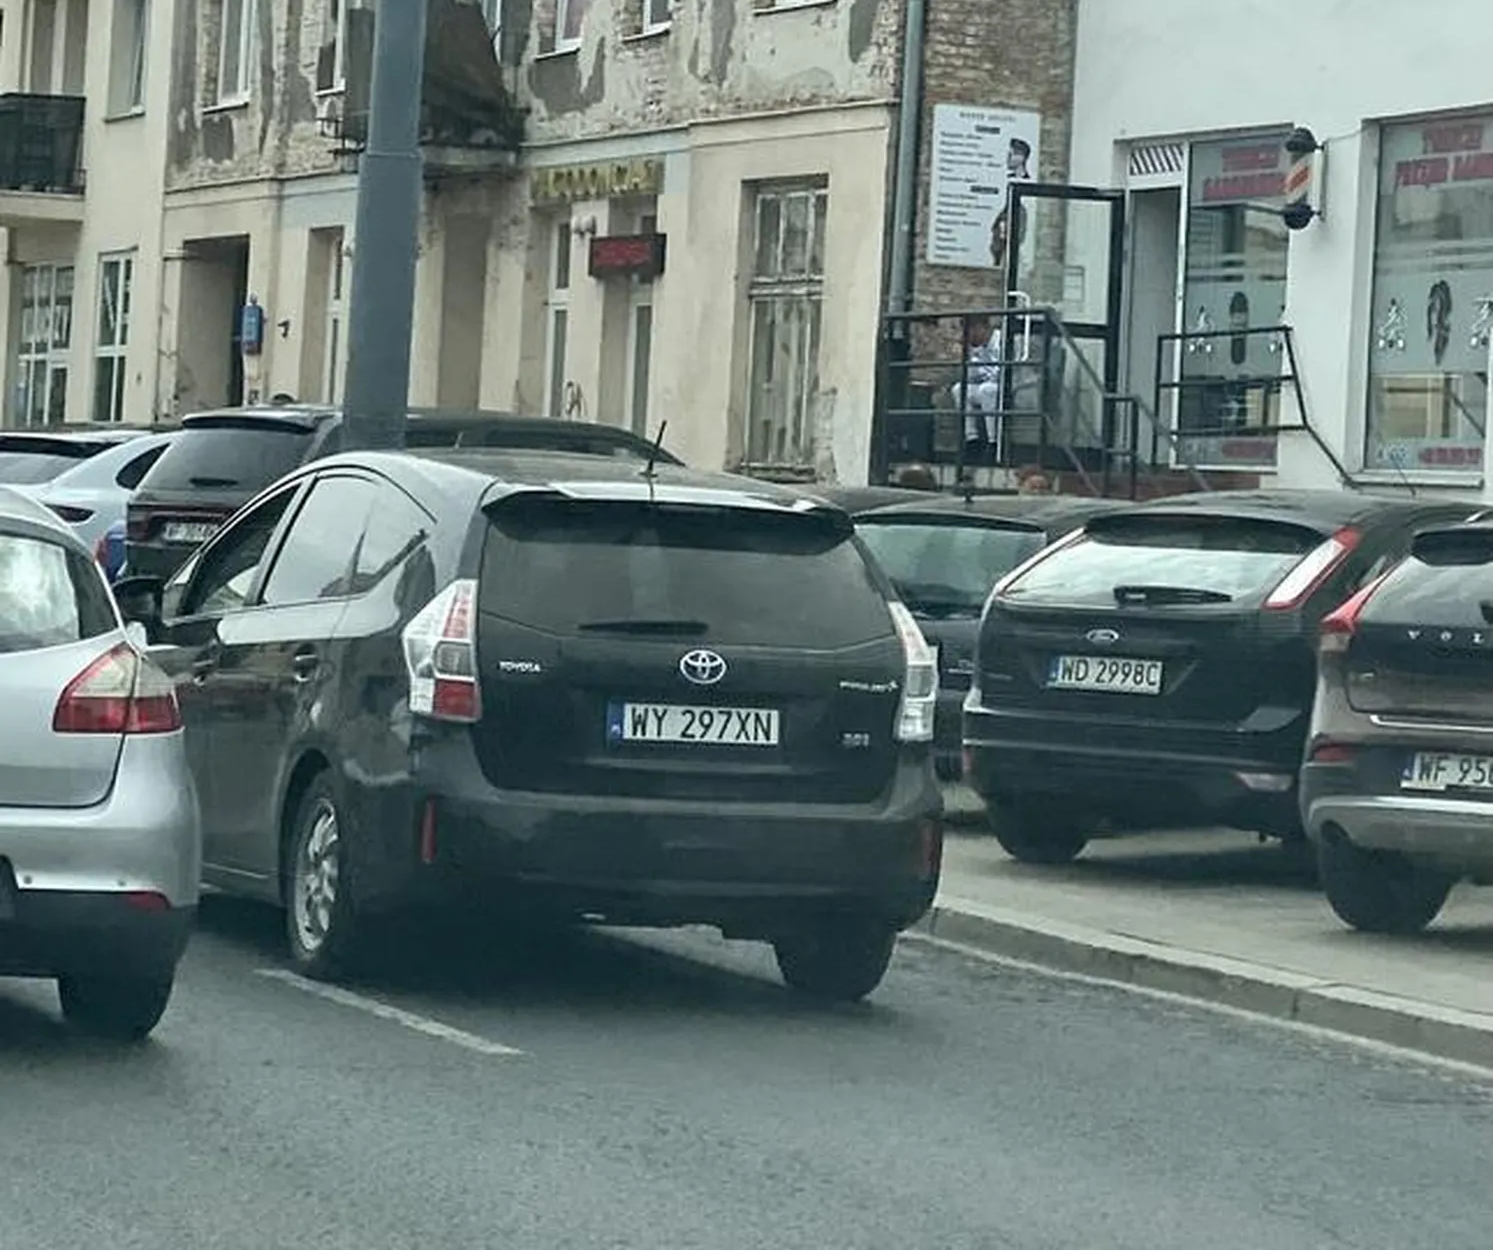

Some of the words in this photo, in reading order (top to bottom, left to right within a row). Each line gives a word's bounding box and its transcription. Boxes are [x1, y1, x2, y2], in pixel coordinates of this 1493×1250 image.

[1061, 658, 1089, 682] WD
[1095, 661, 1159, 687] 2998C
[631, 707, 668, 737] WY
[681, 709, 772, 741] 297XN
[1419, 753, 1448, 782] WF
